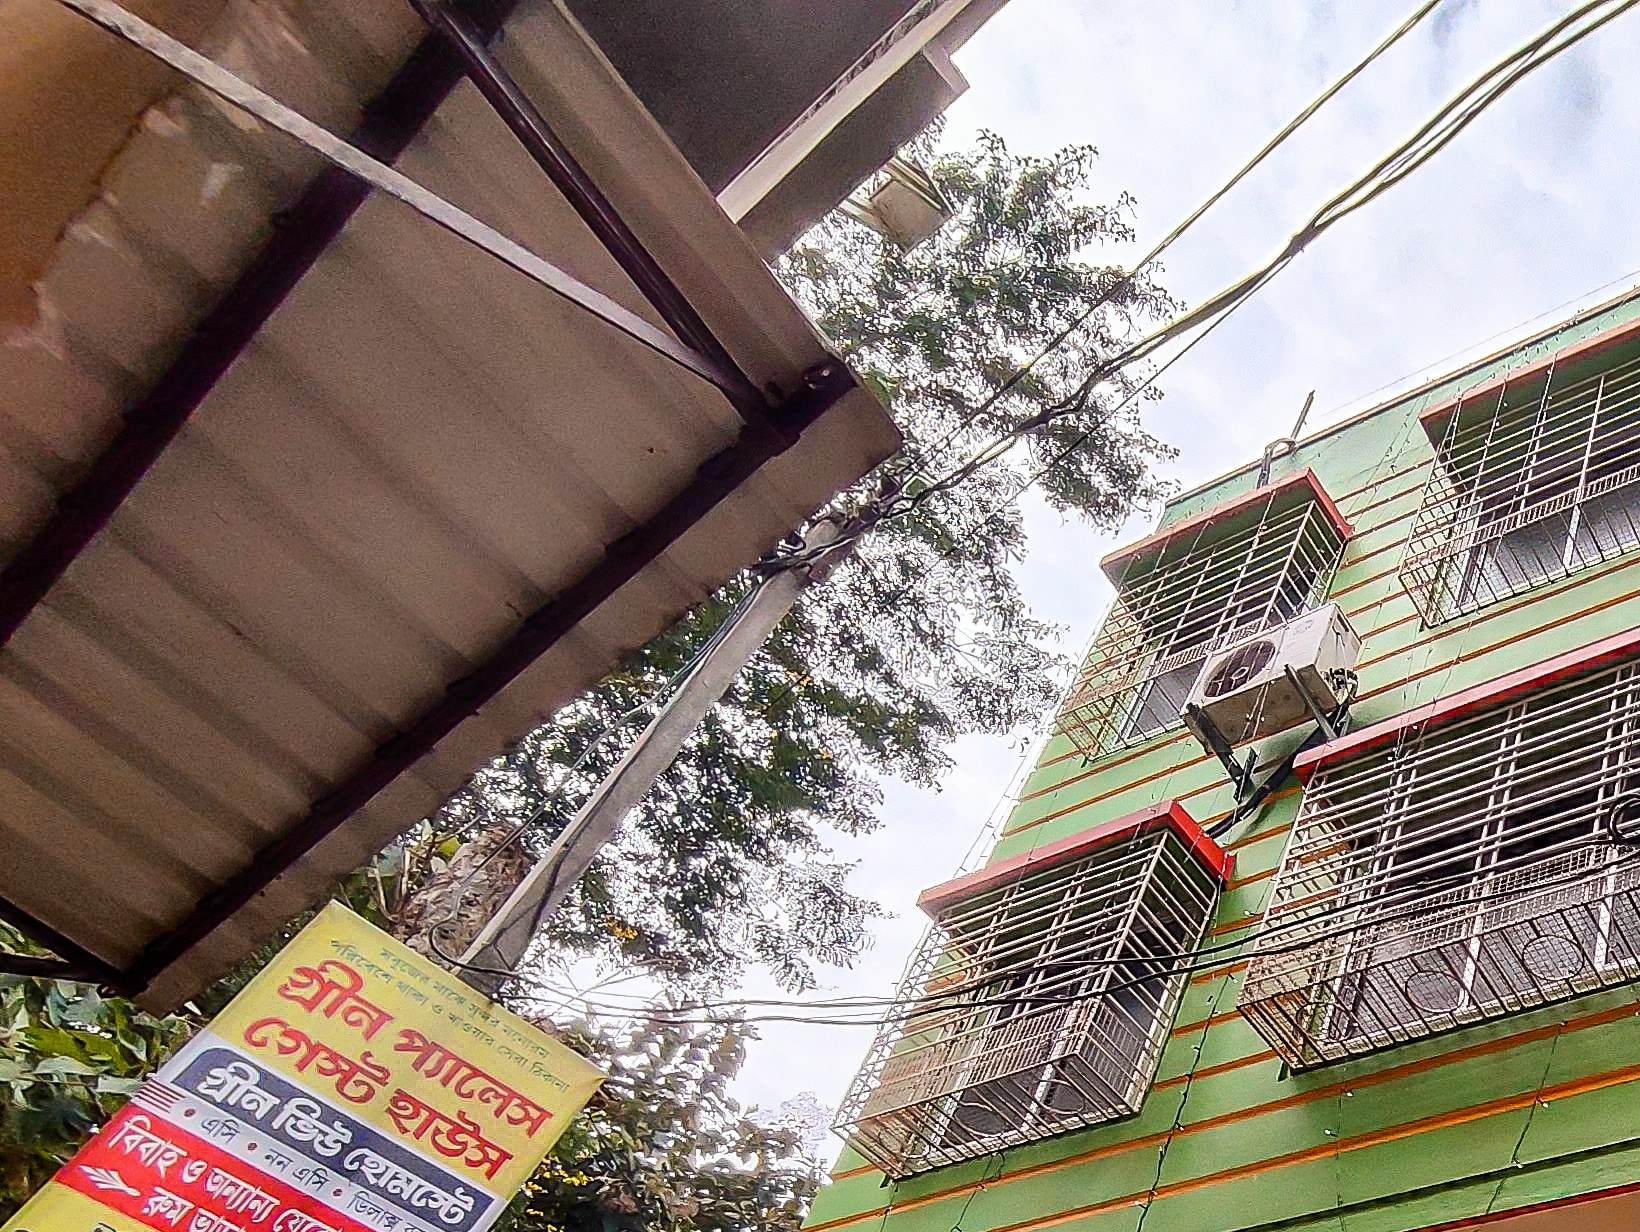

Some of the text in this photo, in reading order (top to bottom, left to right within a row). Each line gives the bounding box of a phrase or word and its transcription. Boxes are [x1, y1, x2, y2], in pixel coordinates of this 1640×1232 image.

[244, 1017, 514, 1181] গেস্ট হাউস
[278, 960, 553, 1139] গ্রীন প্যালেস
[108, 1115, 187, 1178] বিবাহ
[182, 1158, 208, 1183] ও
[206, 1165, 281, 1223] অন্যান্য
[141, 1186, 195, 1228] রুম
[197, 1063, 475, 1226] গ্রীন ভিউ হোমস্টে
[200, 1118, 241, 1145] এসি
[264, 1149, 293, 1171] নন
[292, 1168, 329, 1193] এসি
